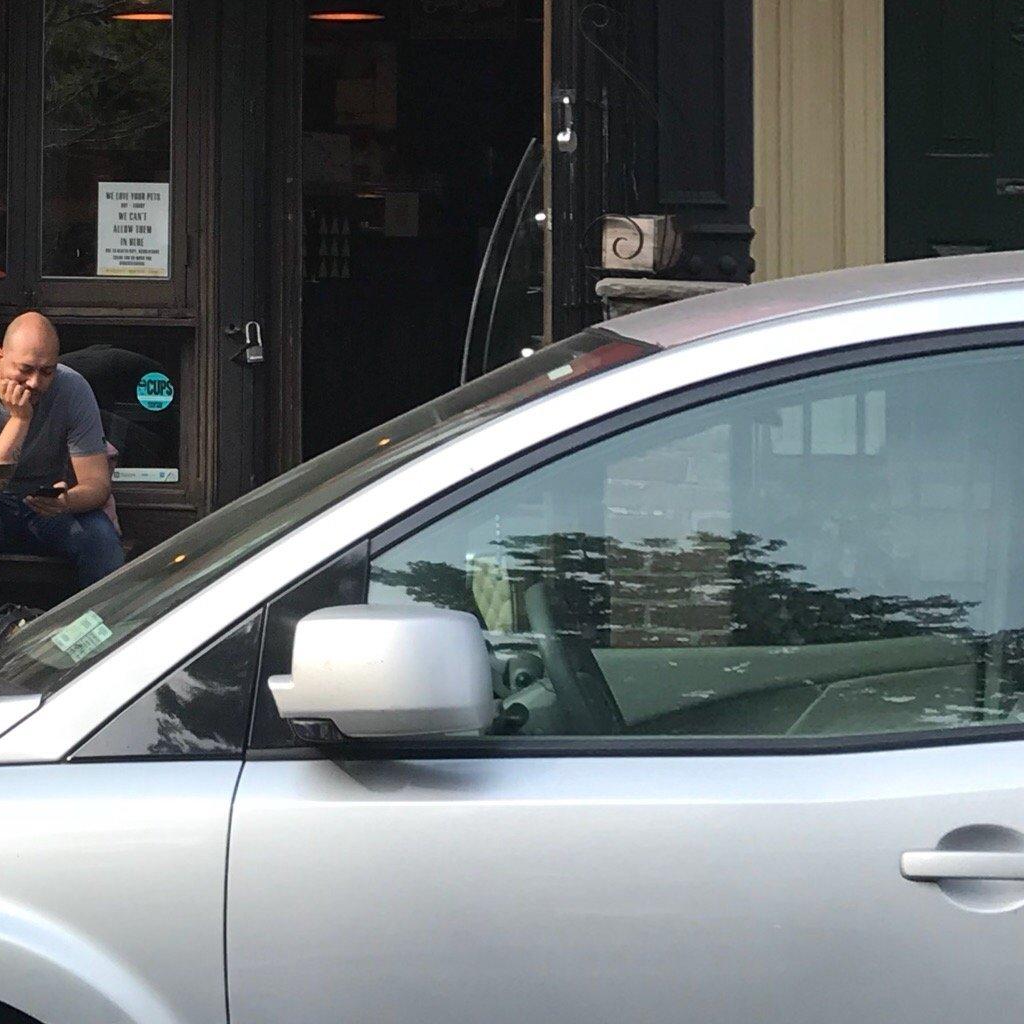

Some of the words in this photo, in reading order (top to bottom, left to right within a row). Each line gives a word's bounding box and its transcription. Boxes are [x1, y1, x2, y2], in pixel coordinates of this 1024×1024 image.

[118, 212, 127, 221] WE
[129, 212, 147, 221] CAN'T
[113, 225, 134, 234] ALLOW
[146, 379, 173, 396] CUPS
